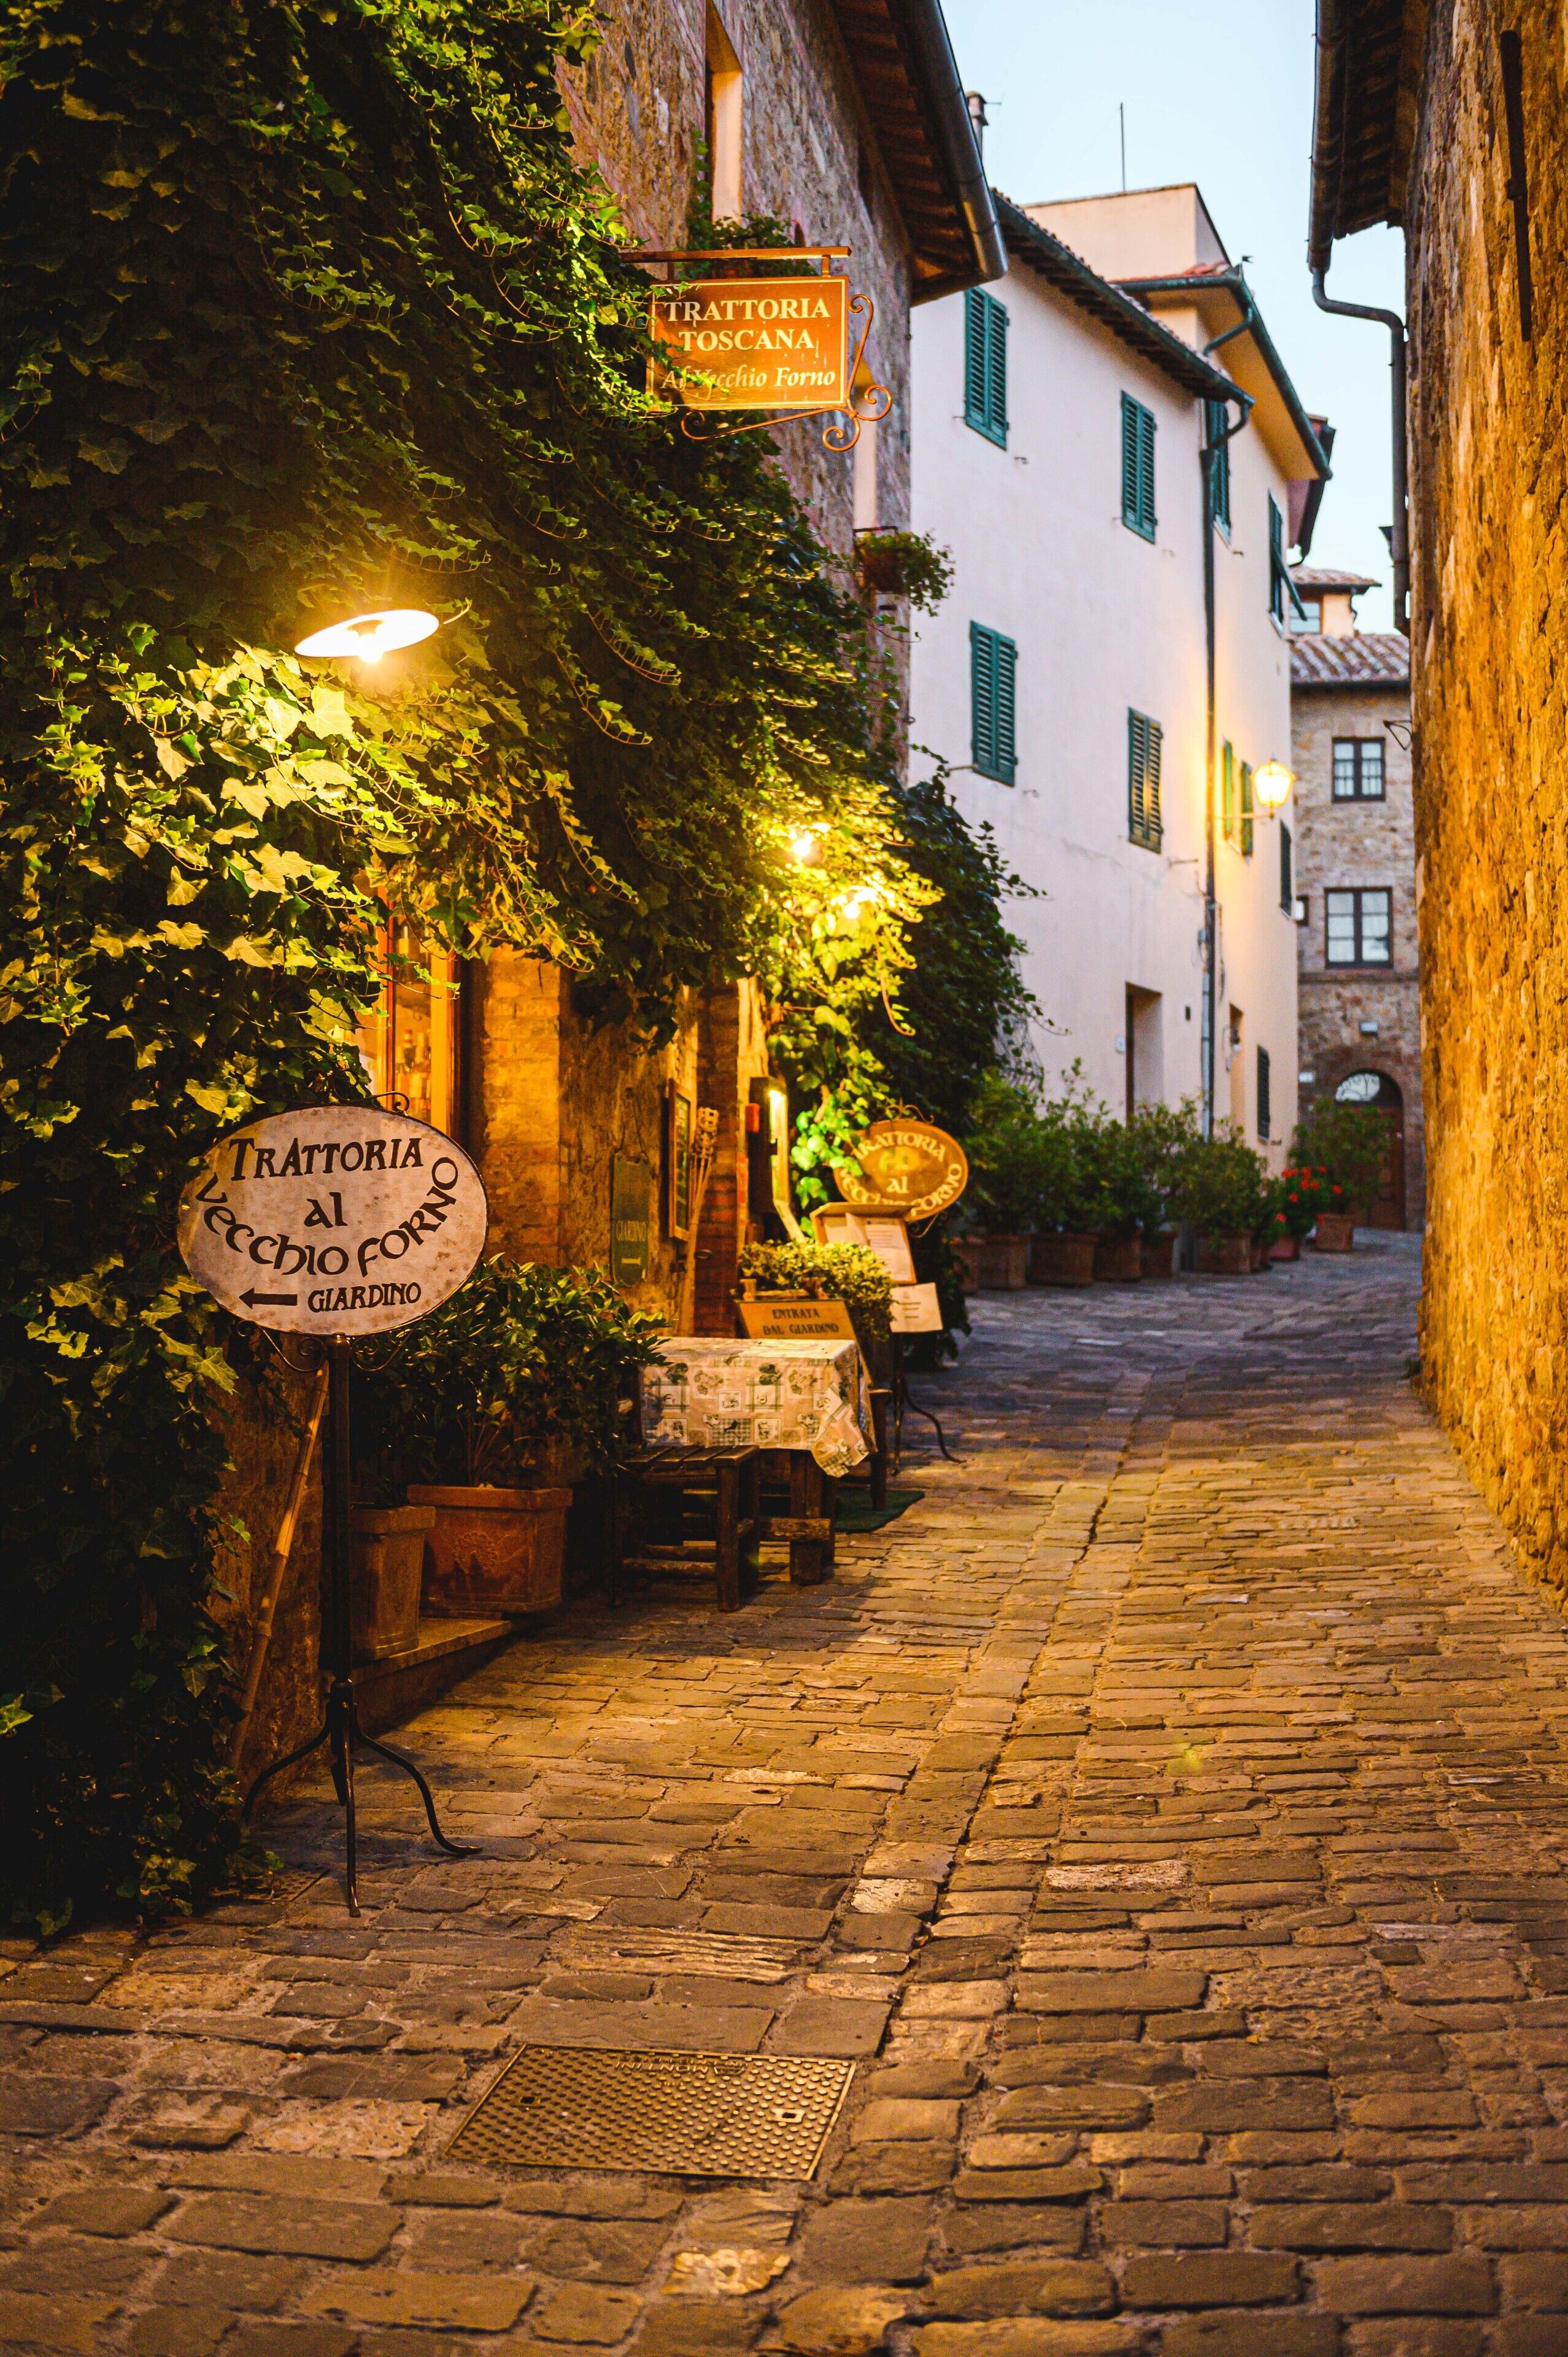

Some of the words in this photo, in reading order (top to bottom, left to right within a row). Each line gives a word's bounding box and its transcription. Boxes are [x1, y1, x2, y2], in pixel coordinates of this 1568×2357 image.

[663, 298, 831, 322] TRATTORIA
[678, 328, 815, 351] TOSCANA
[775, 367, 835, 388] Forno
[228, 1137, 424, 1181] TRATTORIA
[357, 1156, 458, 1277] FORNO
[307, 1282, 422, 1313] GIARDINO
[772, 1308, 820, 1319] ENTRATA
[763, 1325, 784, 1335] DAL
[789, 1323, 840, 1334] GIARDINO
